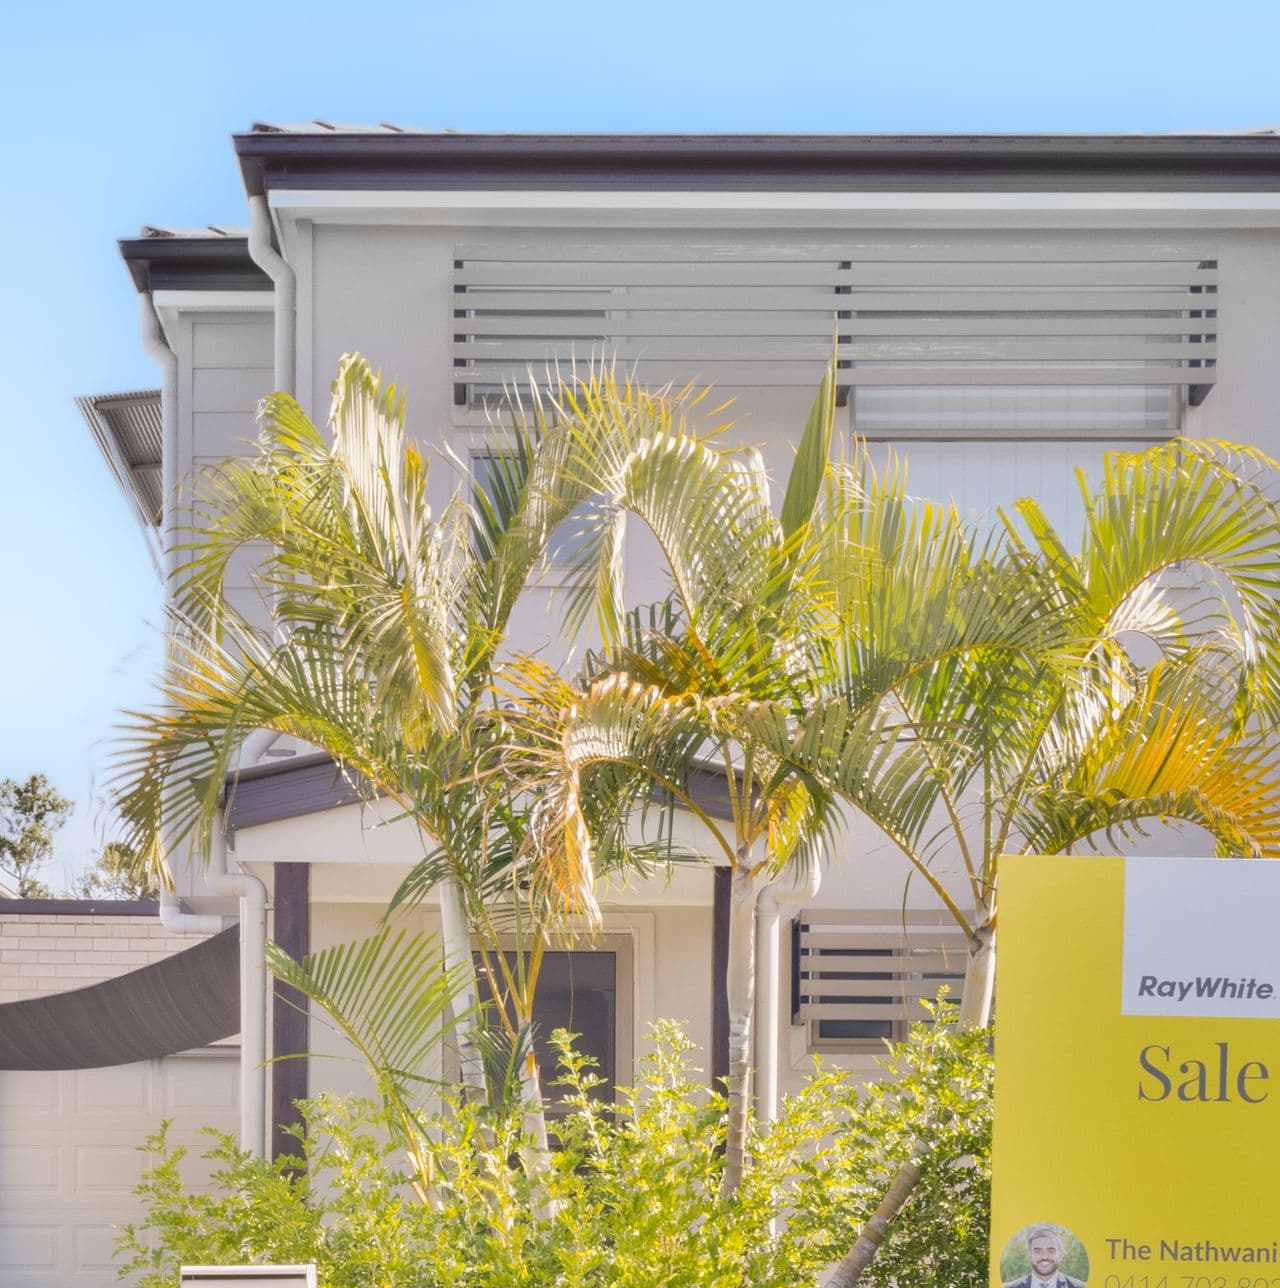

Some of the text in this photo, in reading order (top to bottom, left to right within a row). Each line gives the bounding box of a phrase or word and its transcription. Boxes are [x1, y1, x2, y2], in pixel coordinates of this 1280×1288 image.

[1138, 1041, 1269, 1103] Sale
[1105, 1238, 1151, 1260] The
[1160, 1240, 1277, 1263] Nathwani
